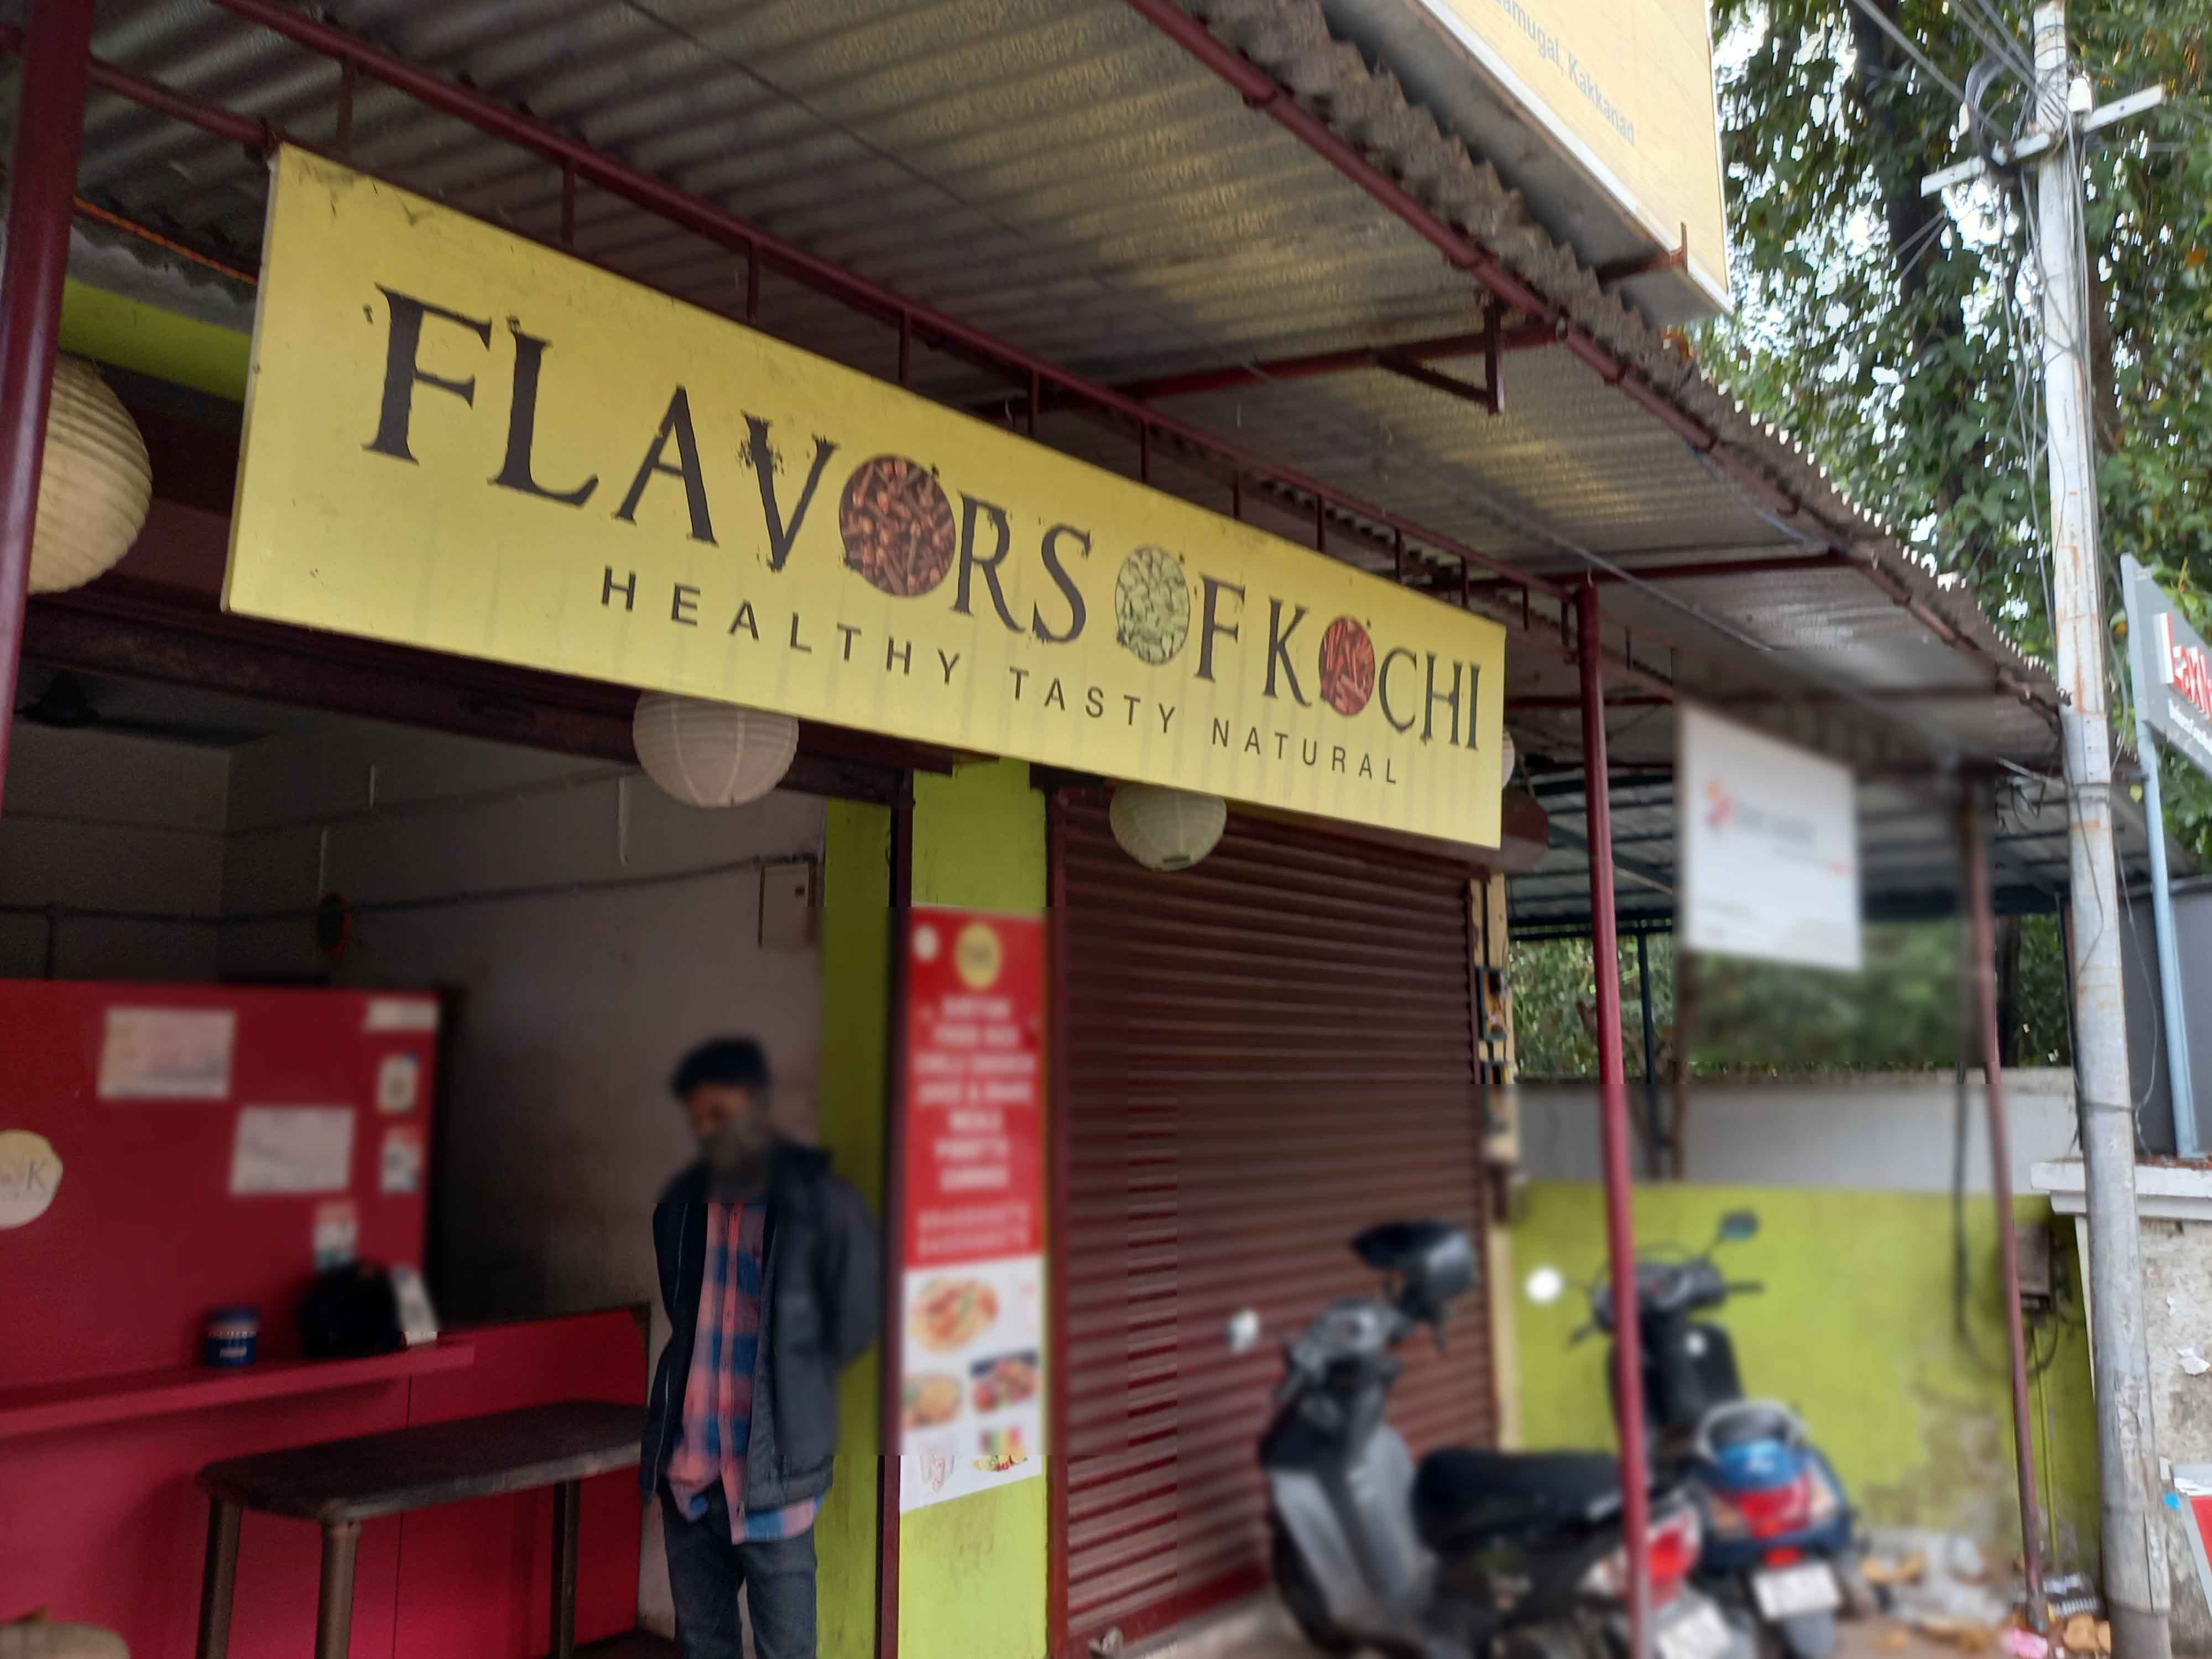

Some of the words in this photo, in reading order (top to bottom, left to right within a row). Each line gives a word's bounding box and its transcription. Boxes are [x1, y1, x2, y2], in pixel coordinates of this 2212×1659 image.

[1495, 0, 1564, 75] amugal,
[1567, 51, 1635, 147] Kakkanad
[362, 283, 1092, 643] FLAVORS
[1115, 545, 1246, 682] OF
[1263, 596, 1481, 751] KOCHI
[601, 564, 960, 685] HEALTHY
[1009, 666, 1176, 734] TASTY
[1211, 717, 1397, 784] NATURAL
